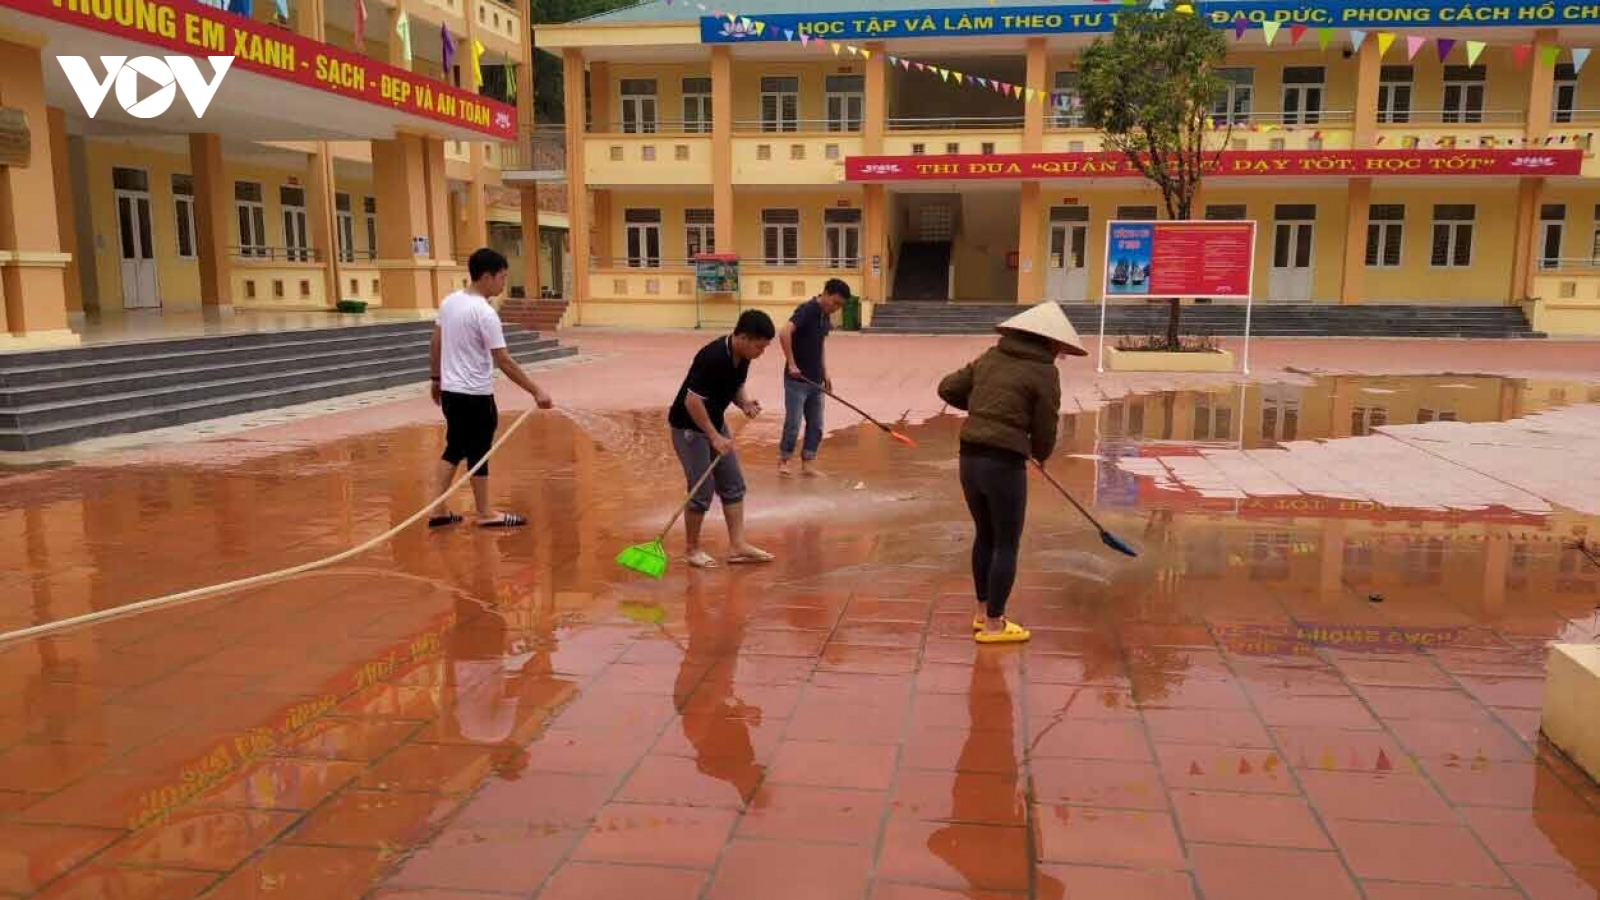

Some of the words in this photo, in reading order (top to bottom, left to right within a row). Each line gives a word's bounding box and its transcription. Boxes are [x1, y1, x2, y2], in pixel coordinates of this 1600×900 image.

[798, 21, 845, 37] HỌC
[853, 17, 897, 36] TẬP
[904, 15, 936, 31] VÀ
[944, 13, 993, 31] LÀM
[1001, 14, 1063, 28] THEO
[1070, 12, 1103, 27] TƯ
[1343, 8, 1430, 21] PHONG
[1439, 4, 1510, 21] CÁCH
[1518, 1, 1555, 19] HỒ
[185, 13, 225, 51] EM
[234, 28, 295, 72] XANH
[316, 54, 365, 91] SẠCH
[414, 84, 433, 111] VÀ
[437, 92, 456, 116] AN
[459, 100, 490, 127] TOÀN
[916, 164, 959, 174] THI
[1234, 159, 1290, 173] DẠY
[1366, 159, 1421, 171] HỌC
